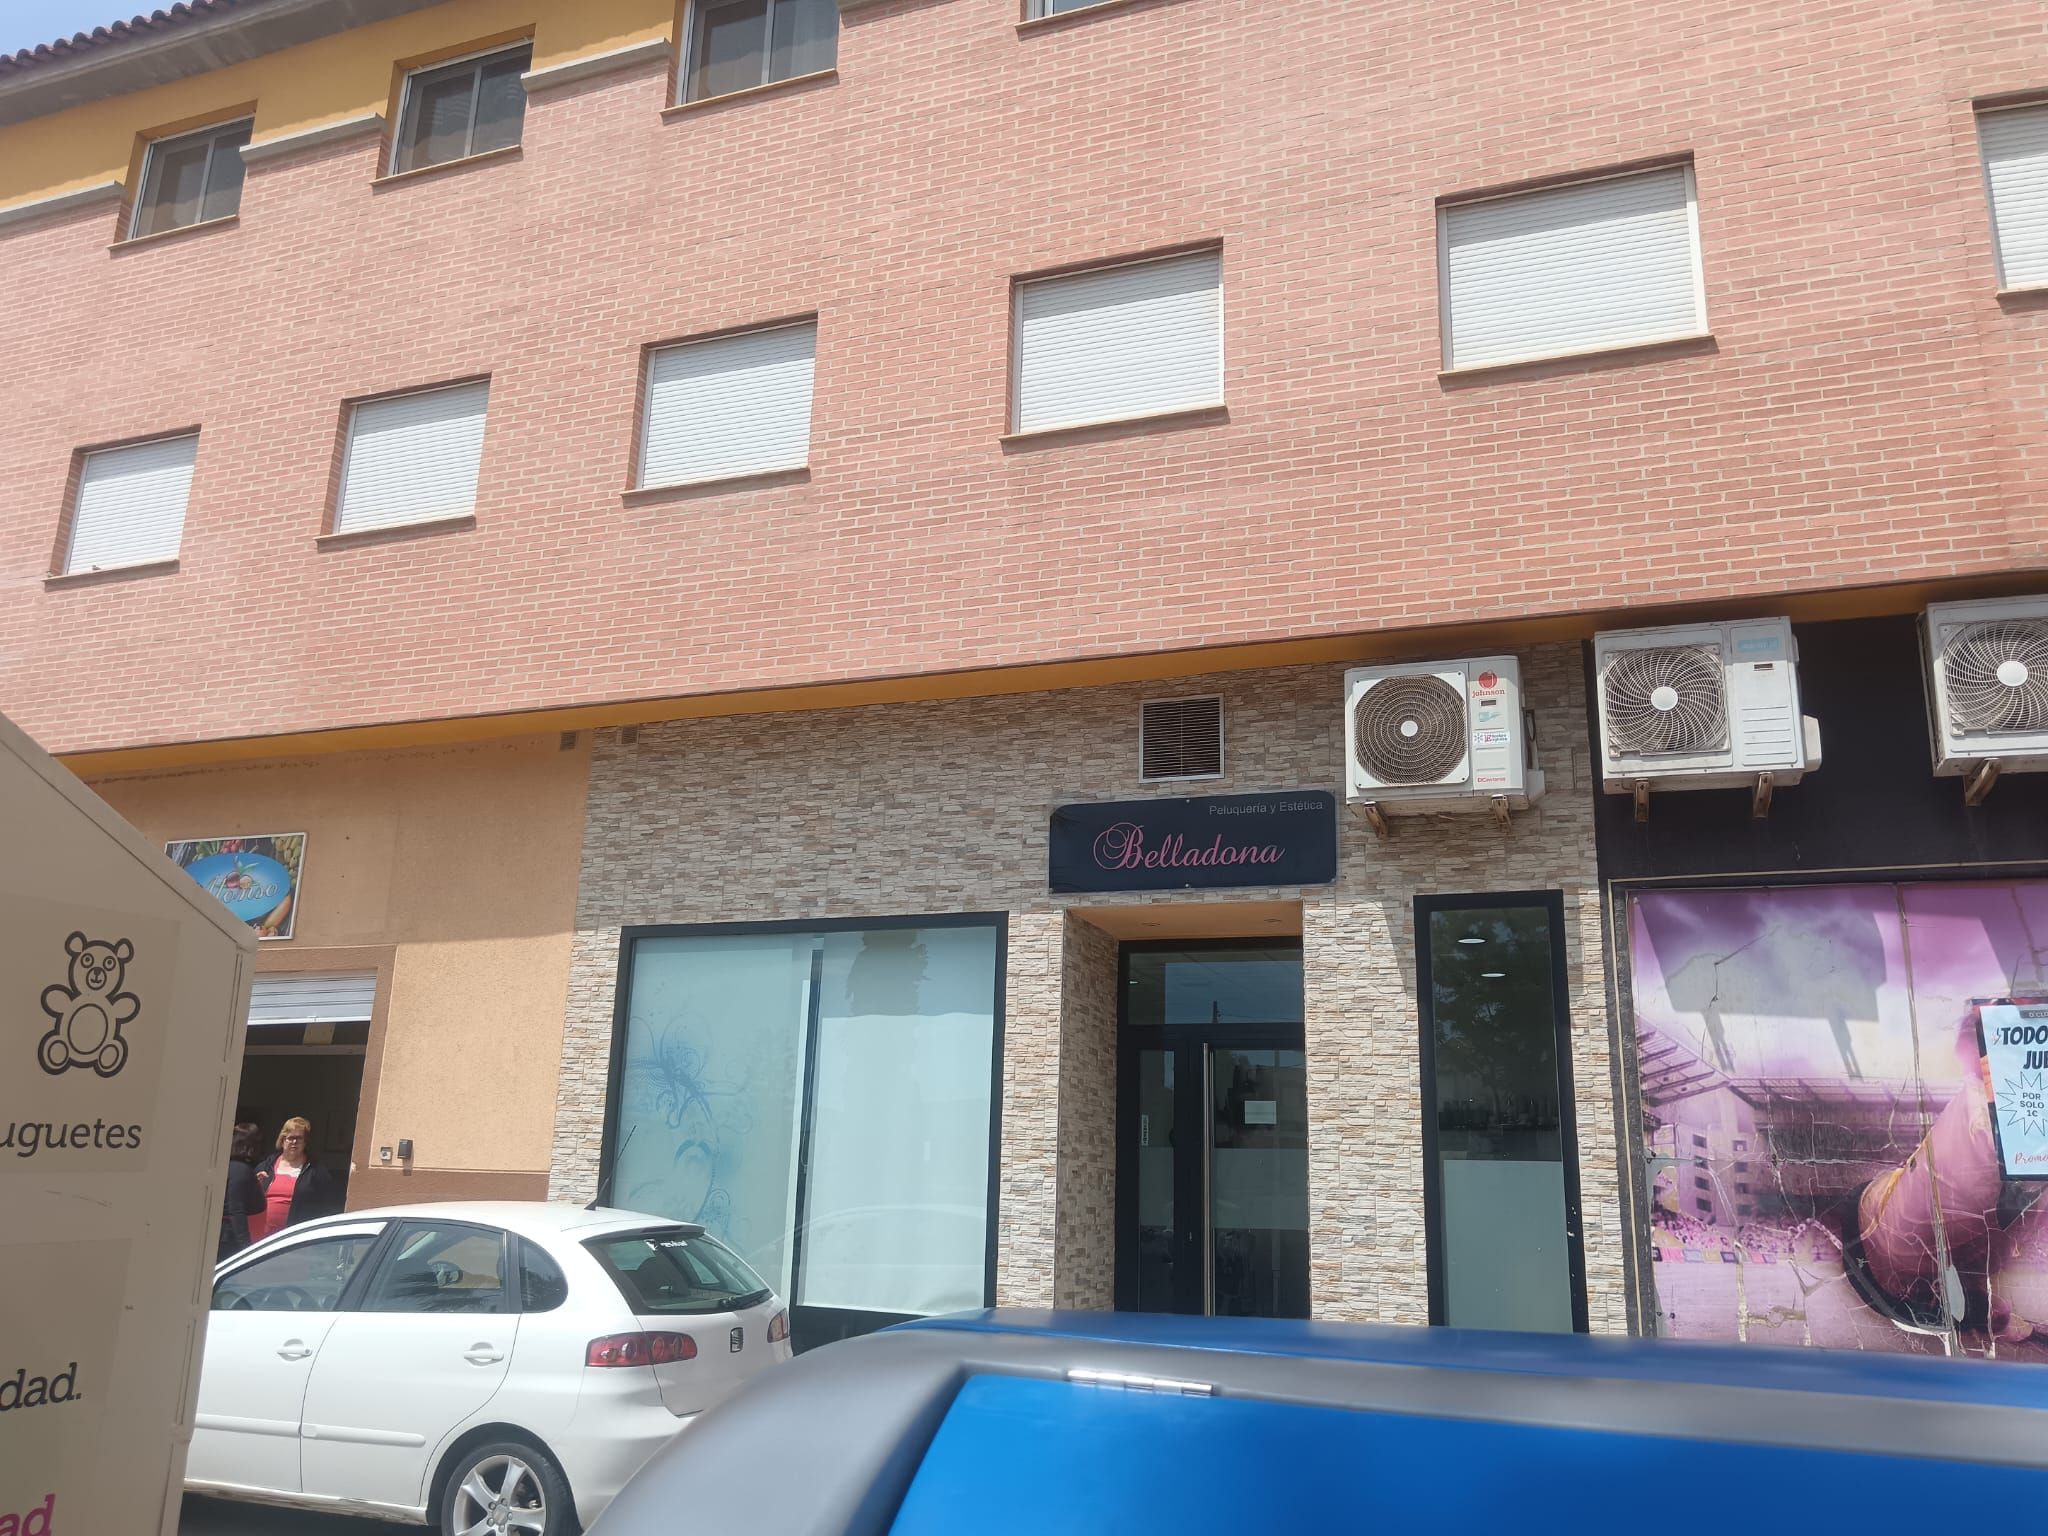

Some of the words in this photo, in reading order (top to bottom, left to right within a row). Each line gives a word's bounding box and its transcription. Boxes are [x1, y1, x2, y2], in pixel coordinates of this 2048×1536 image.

[1270, 804, 1276, 814] y
[1093, 822, 1286, 870] Belladona
[2022, 1092, 2041, 1100] POR
[2020, 1101, 2045, 1109] SOLO
